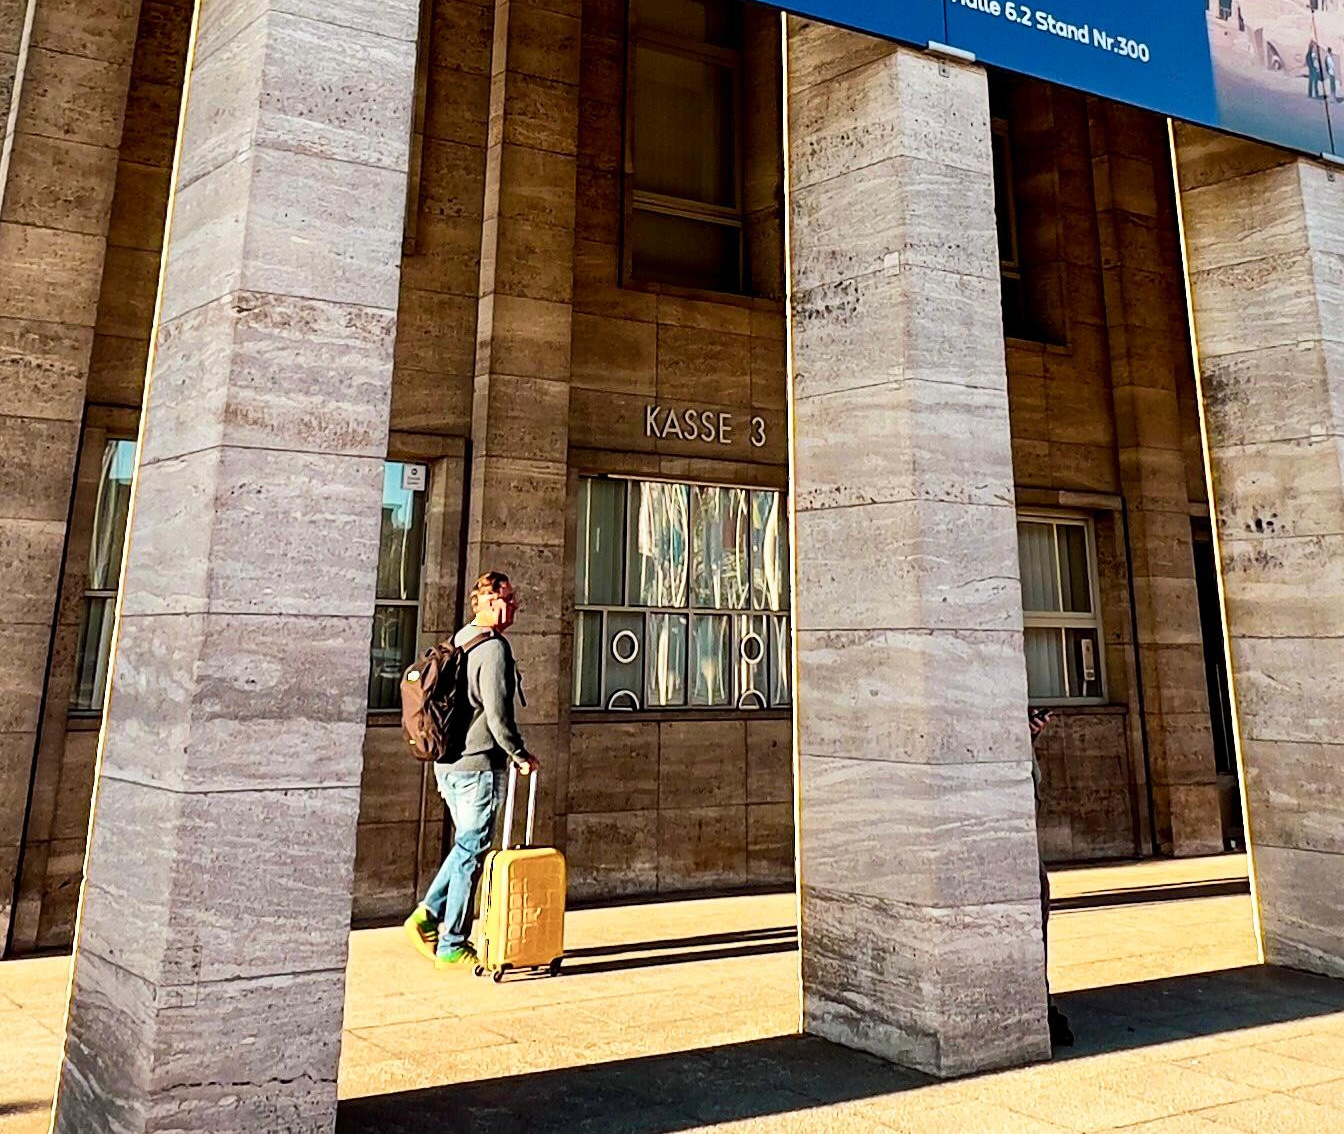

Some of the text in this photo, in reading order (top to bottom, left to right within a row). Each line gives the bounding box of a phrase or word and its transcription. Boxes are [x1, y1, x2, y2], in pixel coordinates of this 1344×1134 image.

[1005, 1, 1032, 27] 6.2
[1036, 11, 1089, 44] Stand
[646, 406, 766, 446] KASSE 3
